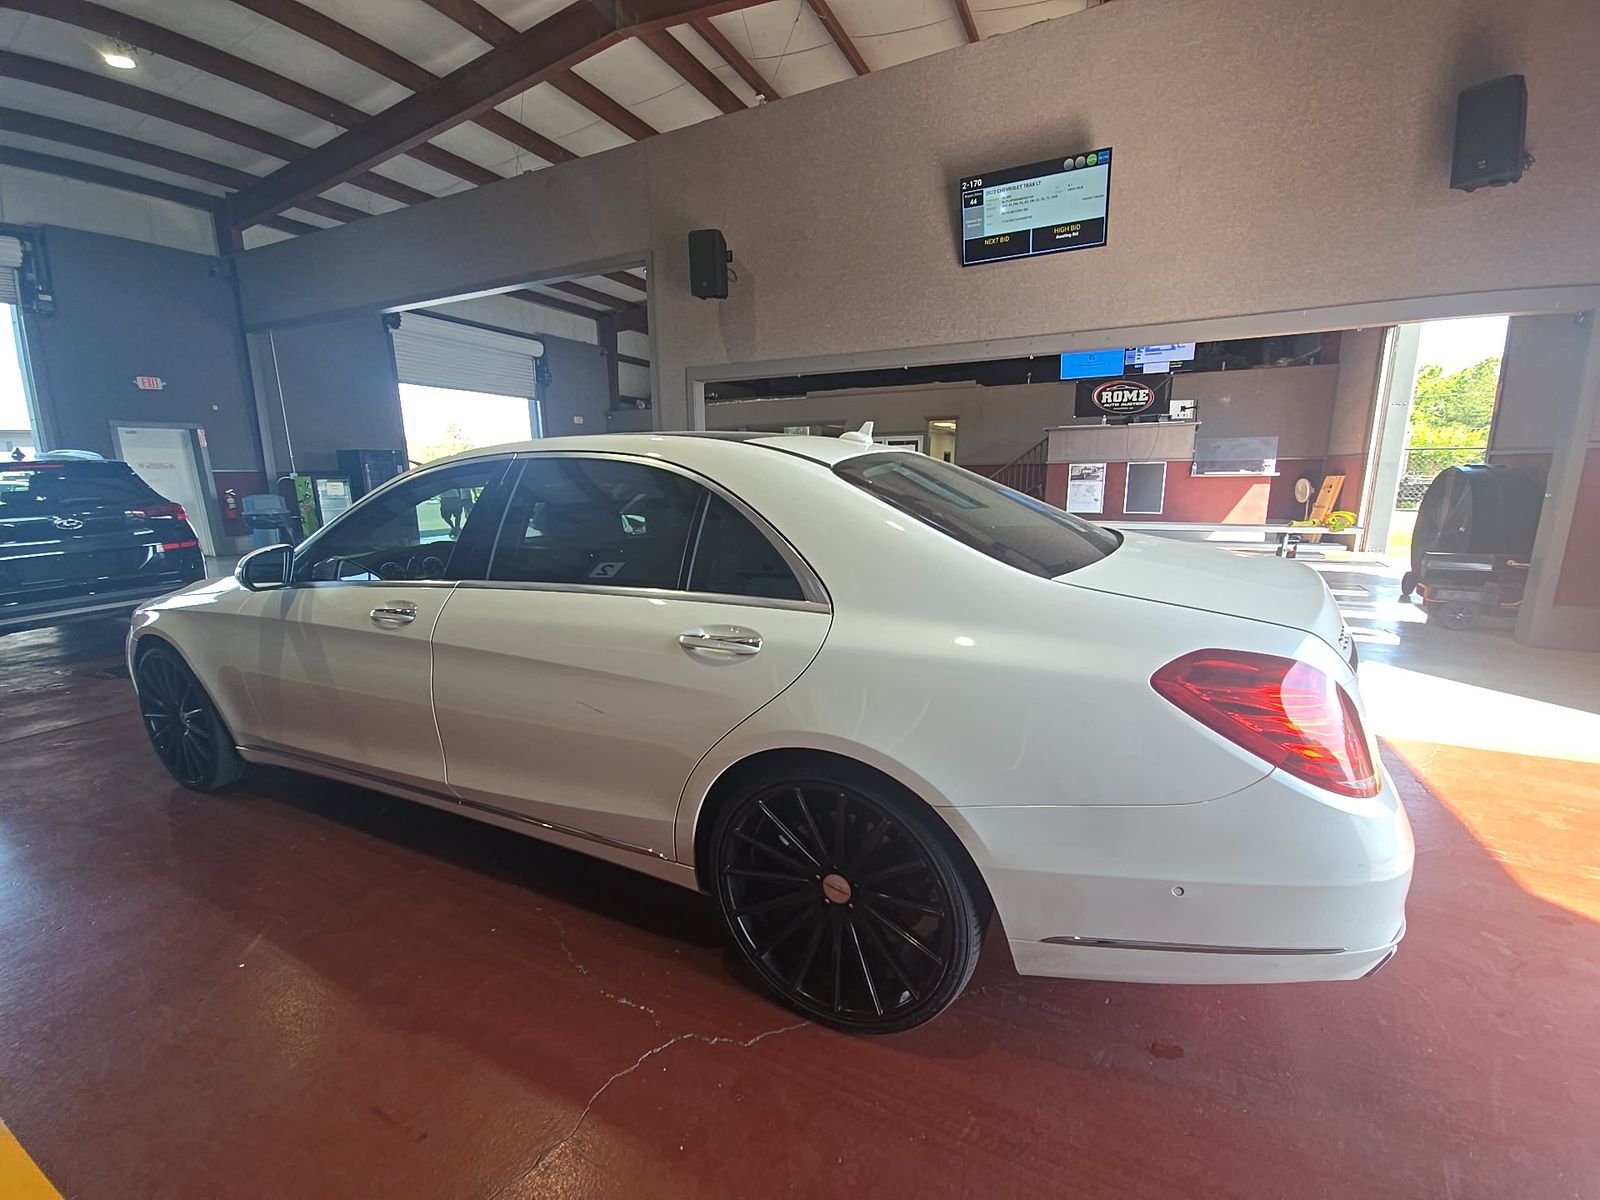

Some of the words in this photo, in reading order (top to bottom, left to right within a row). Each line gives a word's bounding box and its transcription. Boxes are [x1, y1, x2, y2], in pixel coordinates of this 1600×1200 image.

[962, 178, 982, 190] 2-170
[984, 237, 999, 245] NEXT
[141, 378, 160, 388] EXIT
[1101, 390, 1148, 403] ROME
